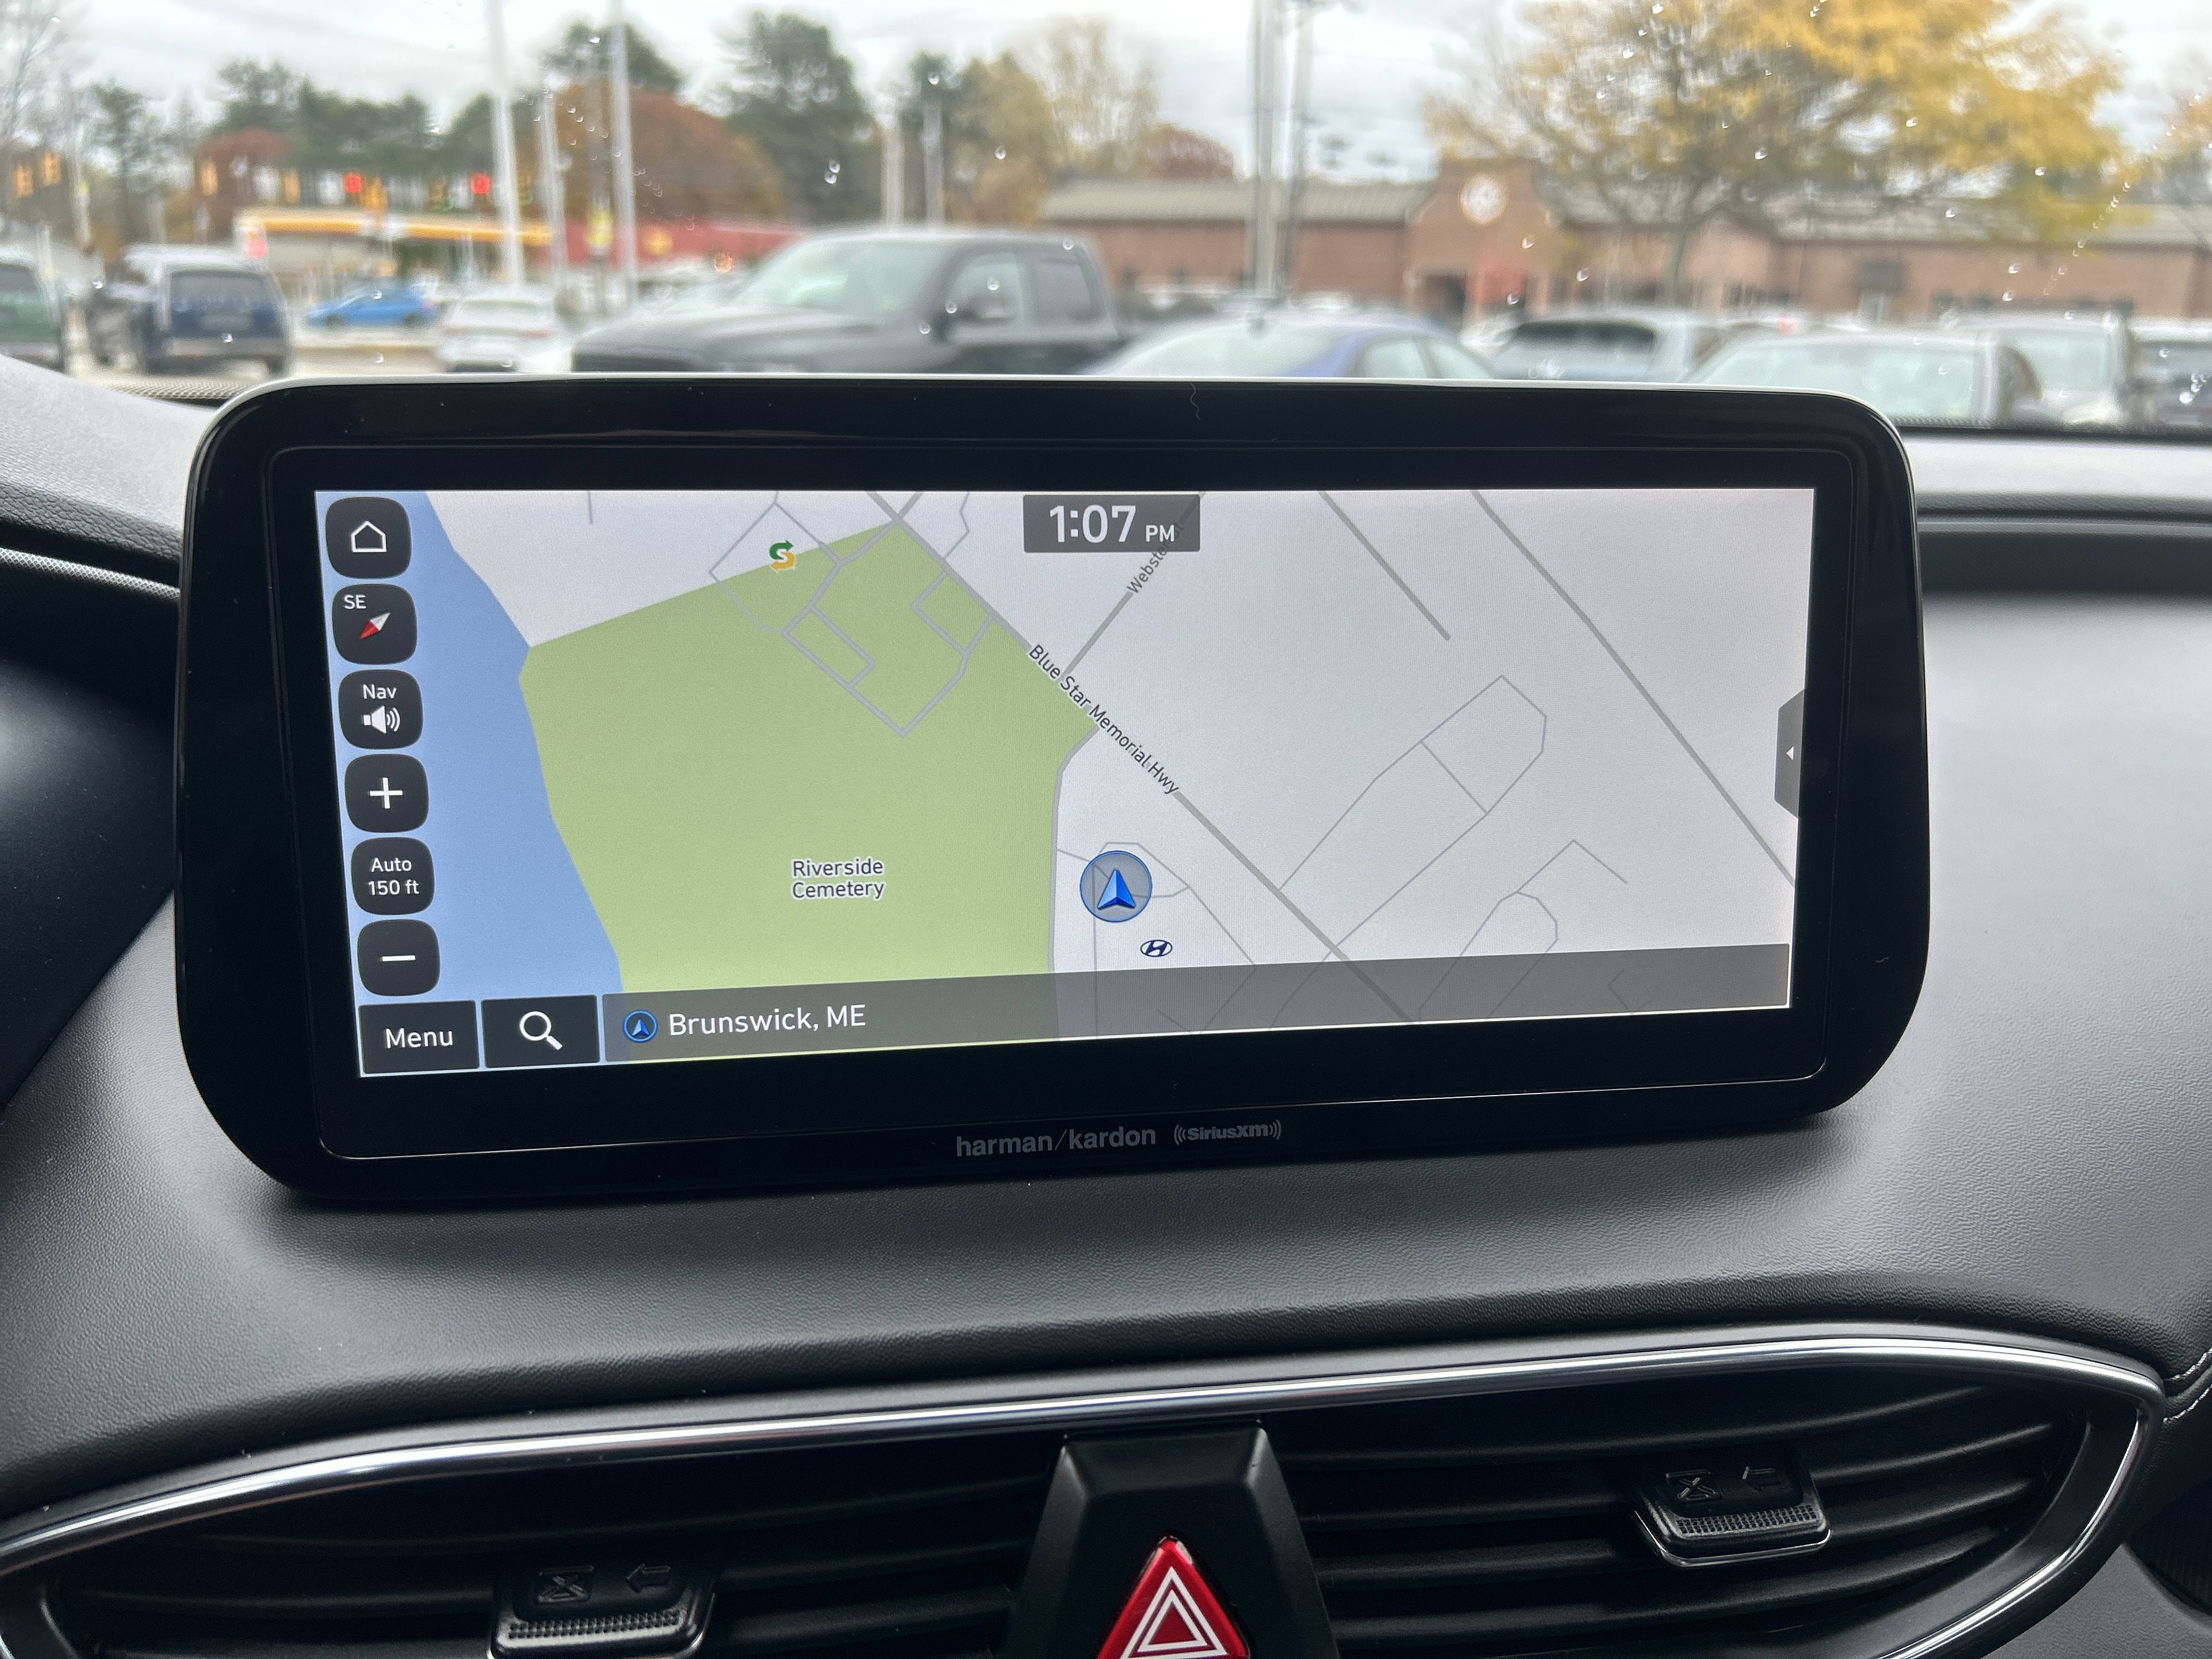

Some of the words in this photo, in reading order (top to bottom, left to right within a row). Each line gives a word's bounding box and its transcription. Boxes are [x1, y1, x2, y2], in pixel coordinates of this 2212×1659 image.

[1049, 505, 1136, 544] 1:07
[1146, 524, 1175, 543] PM
[344, 594, 367, 610] SE
[363, 684, 397, 699] Nav
[1029, 644, 1060, 679] Blue
[1060, 676, 1091, 707] Star
[1088, 704, 1152, 768] Memorial
[1147, 761, 1180, 795] Hwy
[371, 857, 413, 873] Auto
[793, 858, 883, 877] Riverside
[368, 881, 400, 896] 150
[405, 880, 420, 895] ft
[792, 881, 884, 899] Cemetery
[669, 1007, 819, 1036] Brunswick,
[827, 1004, 866, 1028] ME
[385, 1027, 454, 1049] Menu
[956, 1126, 1156, 1157] harman/kardon
